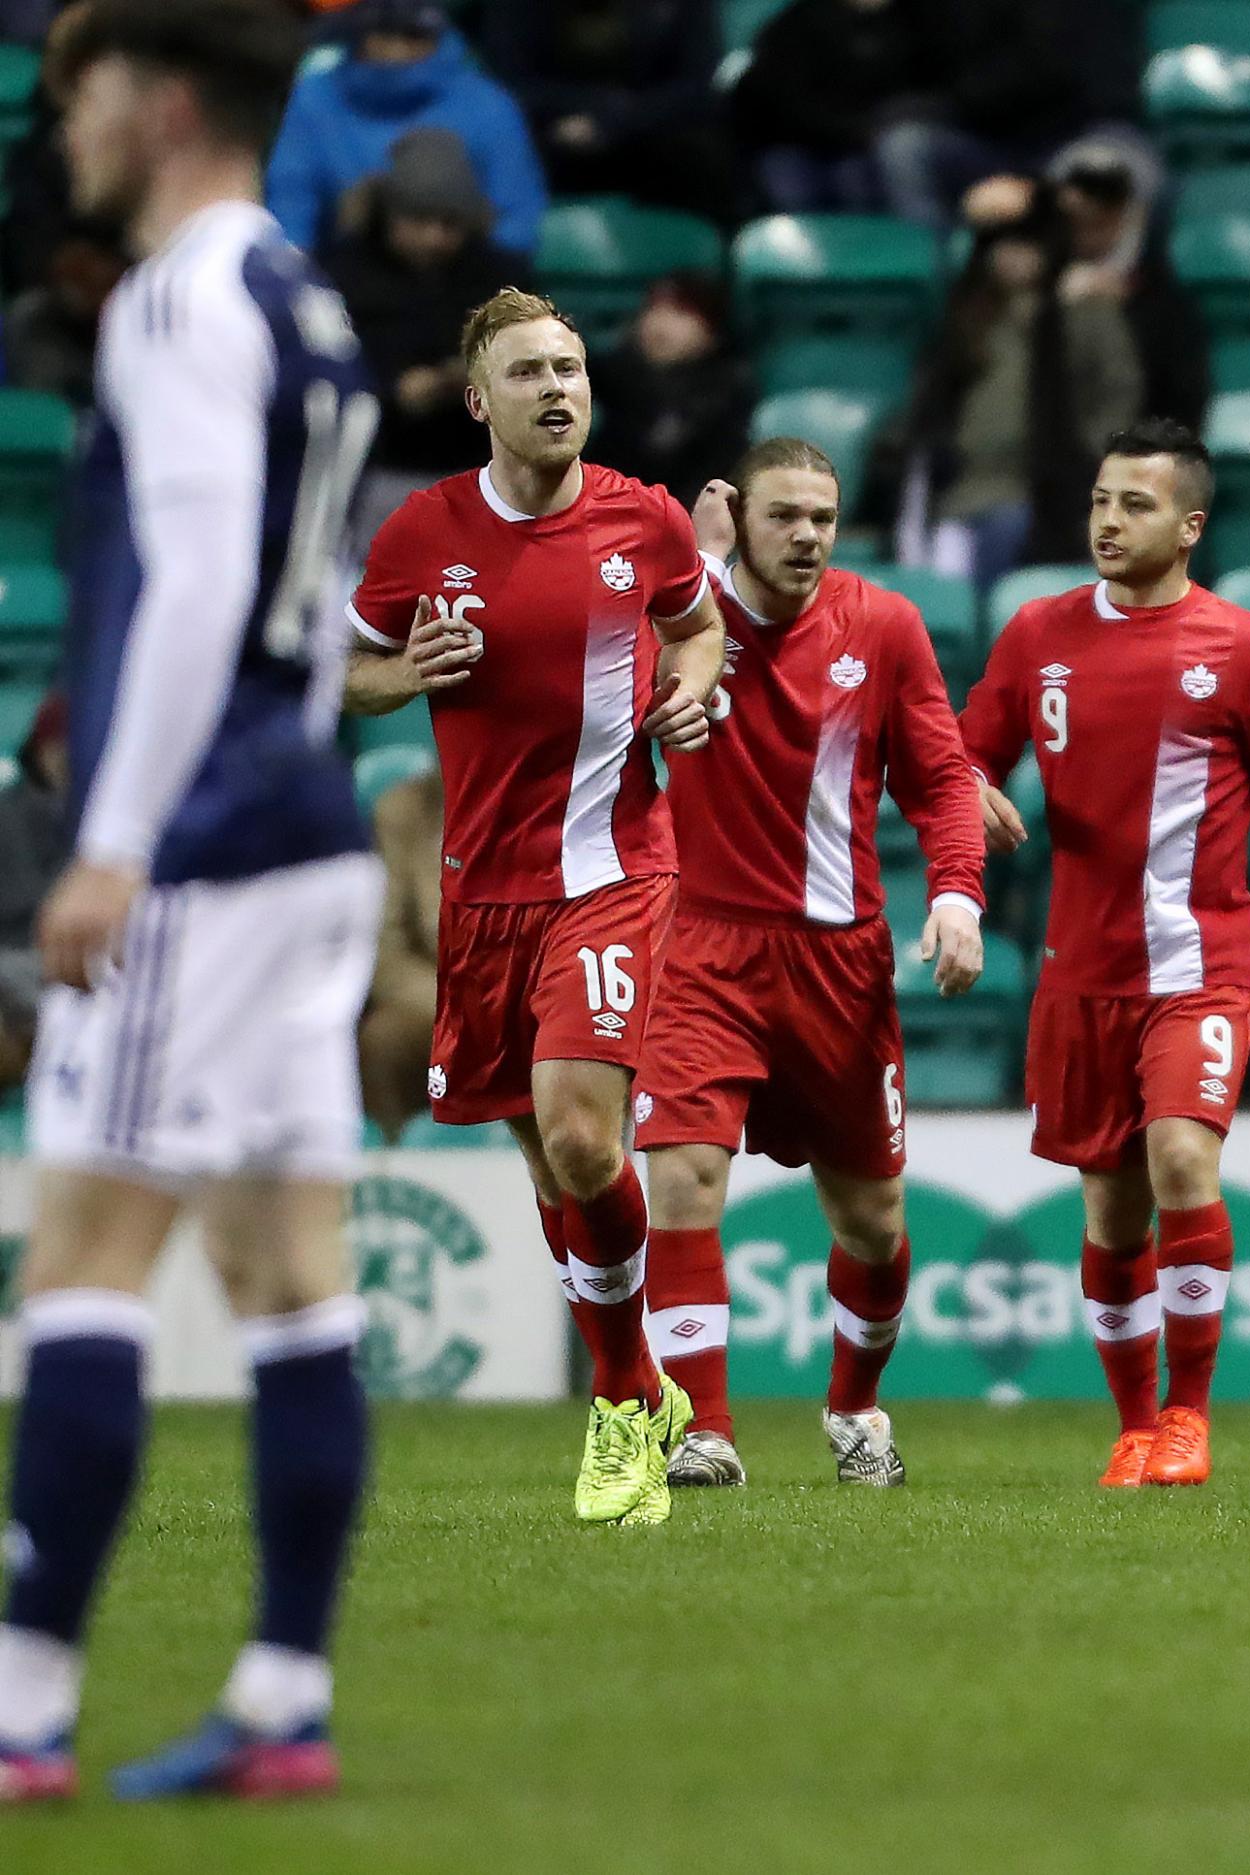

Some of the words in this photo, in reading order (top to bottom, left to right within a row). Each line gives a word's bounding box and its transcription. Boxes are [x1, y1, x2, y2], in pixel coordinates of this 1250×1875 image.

[1041, 686, 1068, 753] 9
[576, 943, 636, 1012] 16
[1200, 1014, 1233, 1077] 9
[883, 1062, 903, 1128] 6
